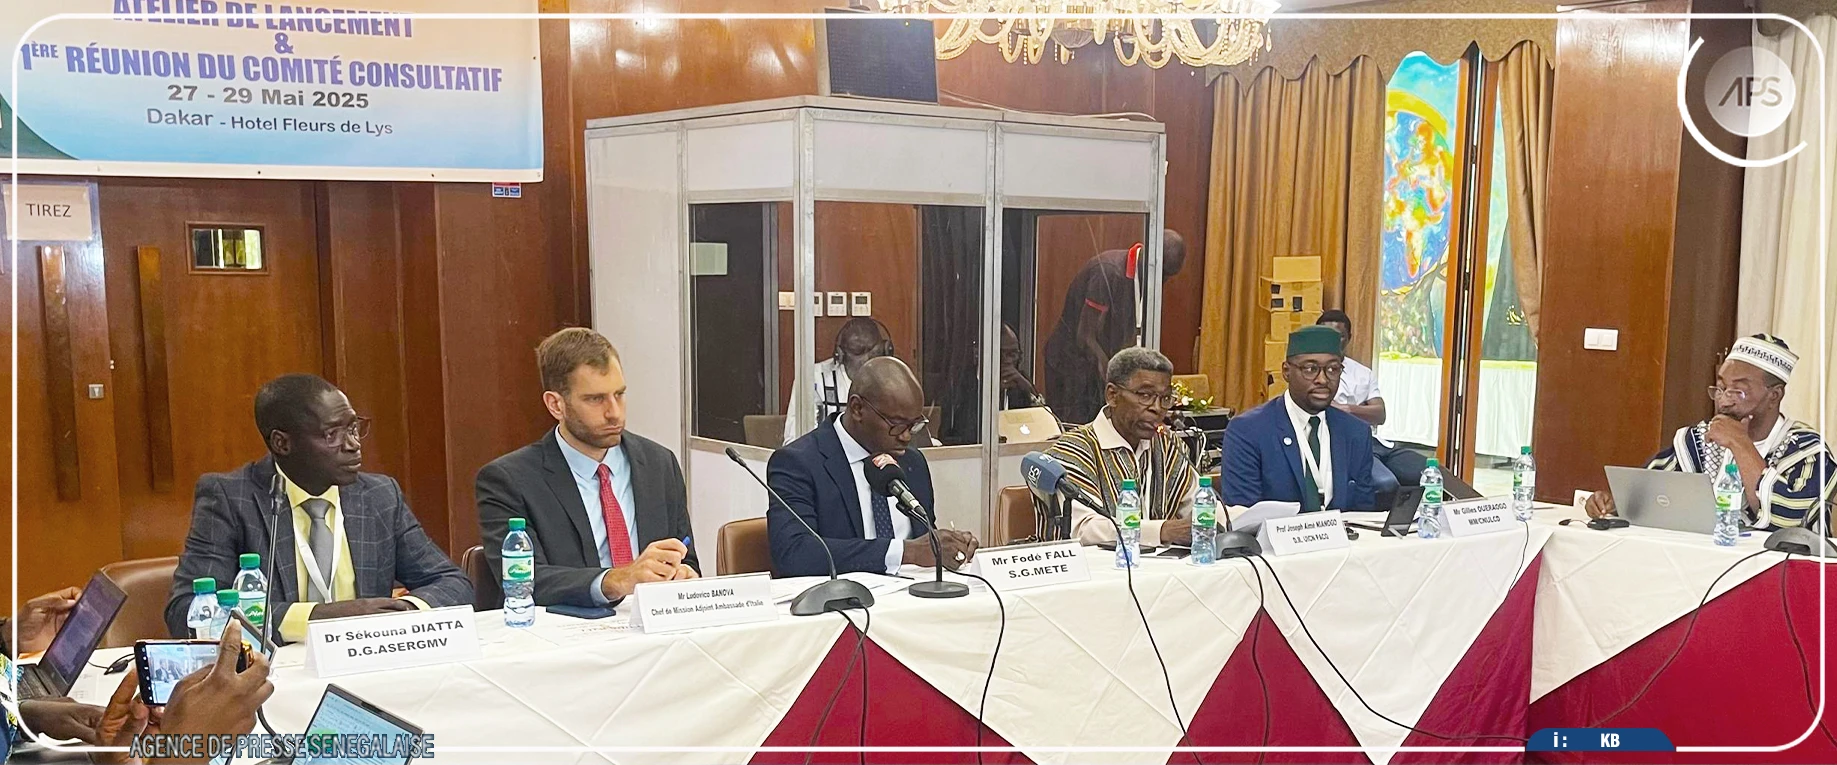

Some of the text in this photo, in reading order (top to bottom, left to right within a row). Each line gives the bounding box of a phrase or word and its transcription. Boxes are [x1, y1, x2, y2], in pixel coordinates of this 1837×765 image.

[225, 1, 260, 29] DE
[265, 4, 412, 37] LANCEMENT
[274, 32, 294, 54] &
[65, 42, 191, 78] RÉUNION
[198, 53, 236, 80] DU
[242, 55, 343, 85] COMITÉ
[349, 61, 502, 92] CONSULTATIF
[168, 85, 198, 101] 27
[223, 87, 252, 103] 29
[261, 88, 303, 106] Mai
[312, 91, 369, 109] 2025
[147, 108, 214, 125] Dakar
[231, 116, 277, 131] Hotel
[283, 118, 336, 132] Fleurs
[340, 121, 361, 134] de
[366, 121, 393, 137] Lys
[25, 203, 72, 217] TIREZ
[992, 549, 1077, 566] Mr Fodé FALL
[1008, 564, 1069, 578] S.G.METE
[678, 588, 735, 600] Mr Ludovico BANOVA
[651, 607, 664, 616] Chef
[665, 607, 673, 615] de
[673, 604, 694, 614] Mission
[695, 603, 714, 614] Adjoint
[715, 601, 745, 611] Ambassade
[324, 619, 464, 643] Dr Sékouna DIATTA
[347, 637, 448, 658] D.G.ASERGMV
